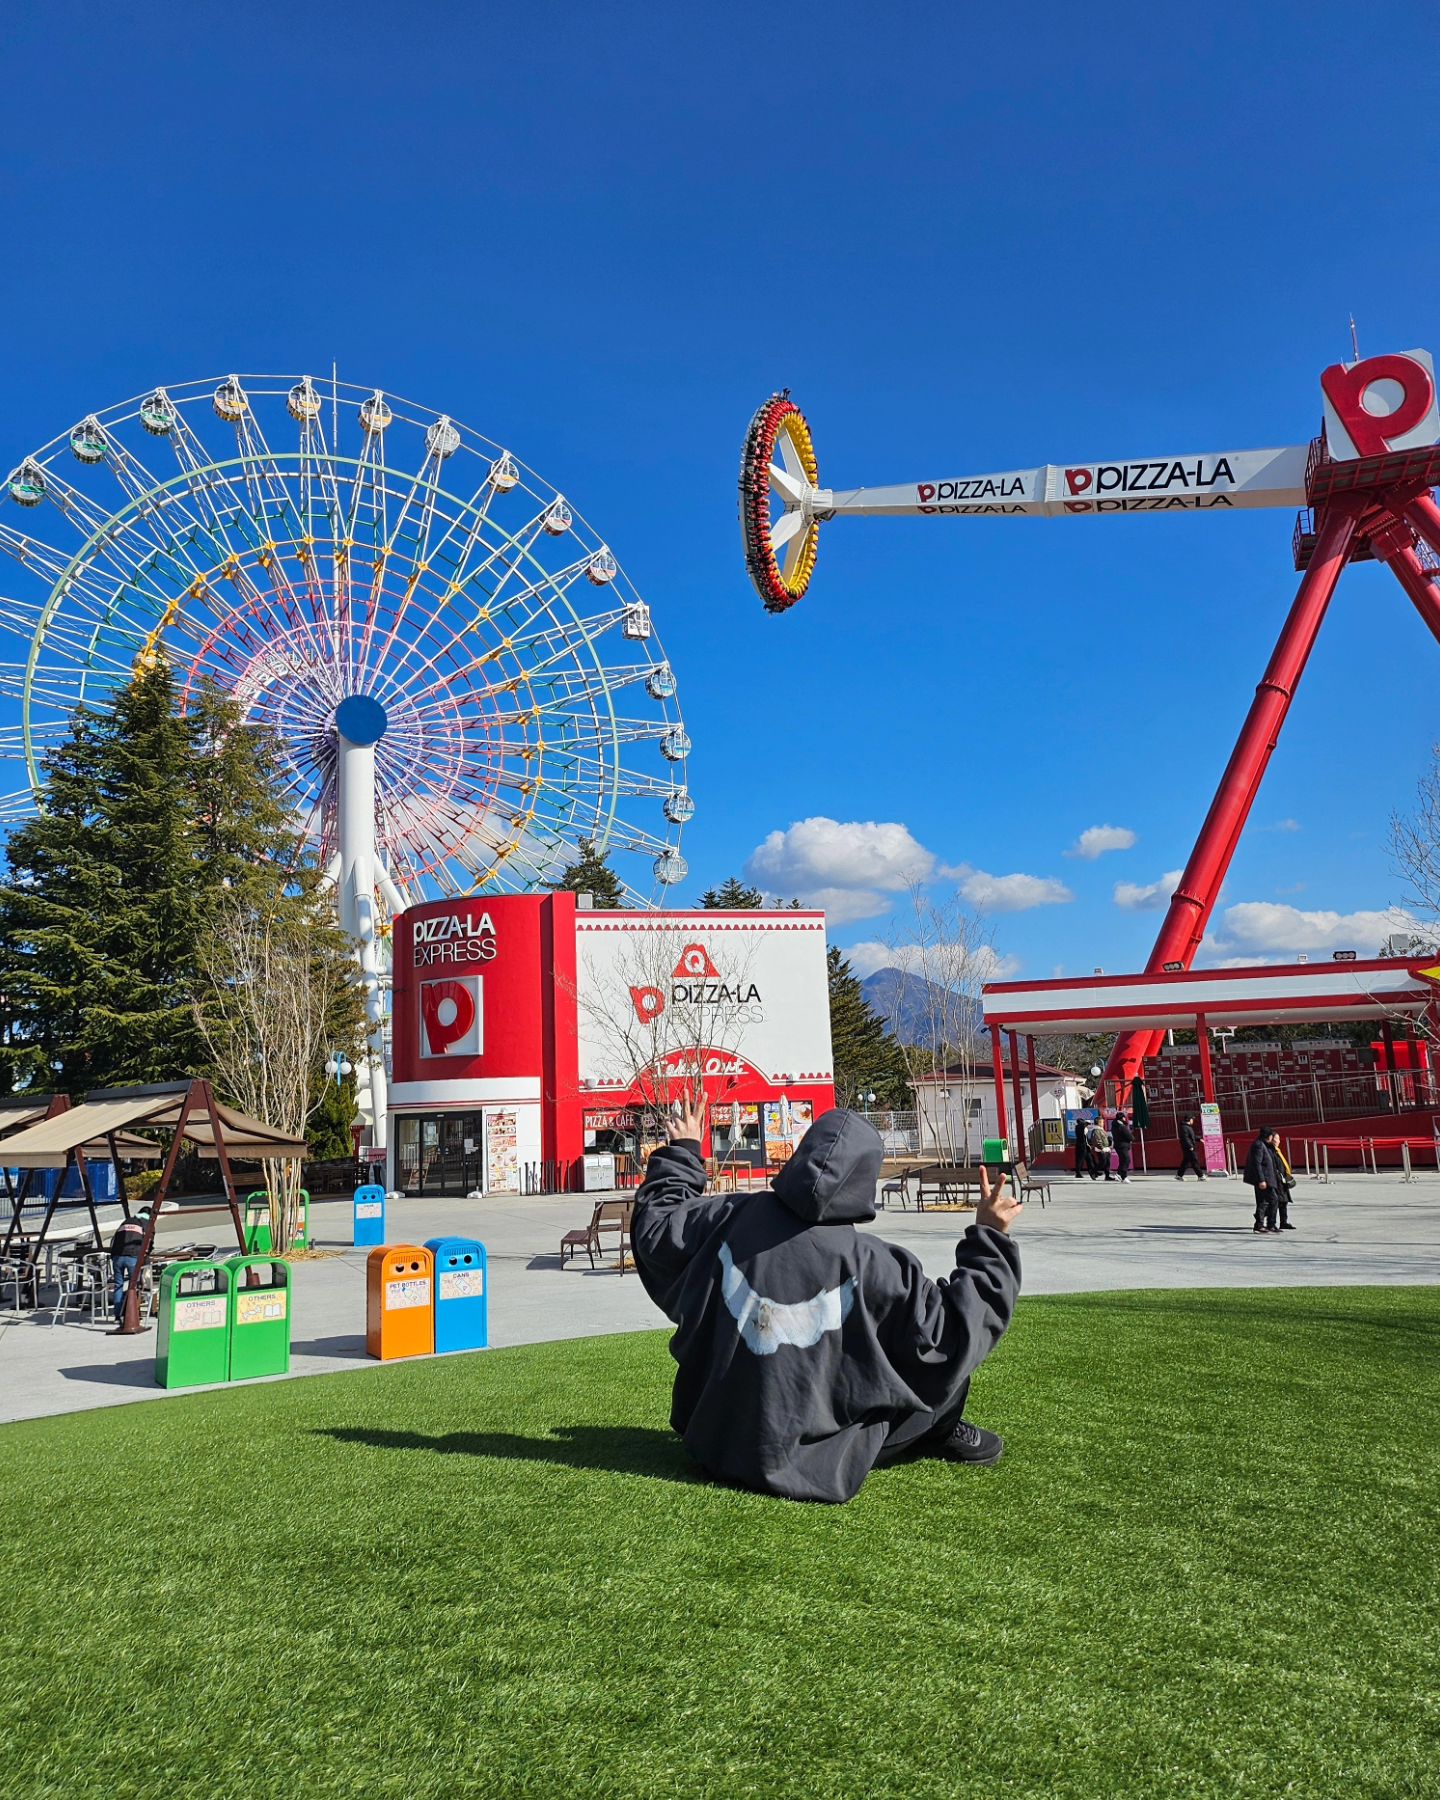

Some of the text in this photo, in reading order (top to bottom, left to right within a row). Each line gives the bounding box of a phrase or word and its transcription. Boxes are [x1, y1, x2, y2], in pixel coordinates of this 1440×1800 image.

[413, 912, 497, 946] PIZZA-LA
[413, 938, 497, 968] EXPRESS
[684, 949, 706, 975] Q
[671, 1005, 764, 1024] EXPRESS
[705, 1057, 746, 1075] Out
[584, 1115, 610, 1128] PIZZA
[609, 1116, 615, 1127] &
[401, 1280, 427, 1288] BOTTLES
[186, 1299, 216, 1309] OTHERS
[248, 1293, 277, 1302] OTHERS
